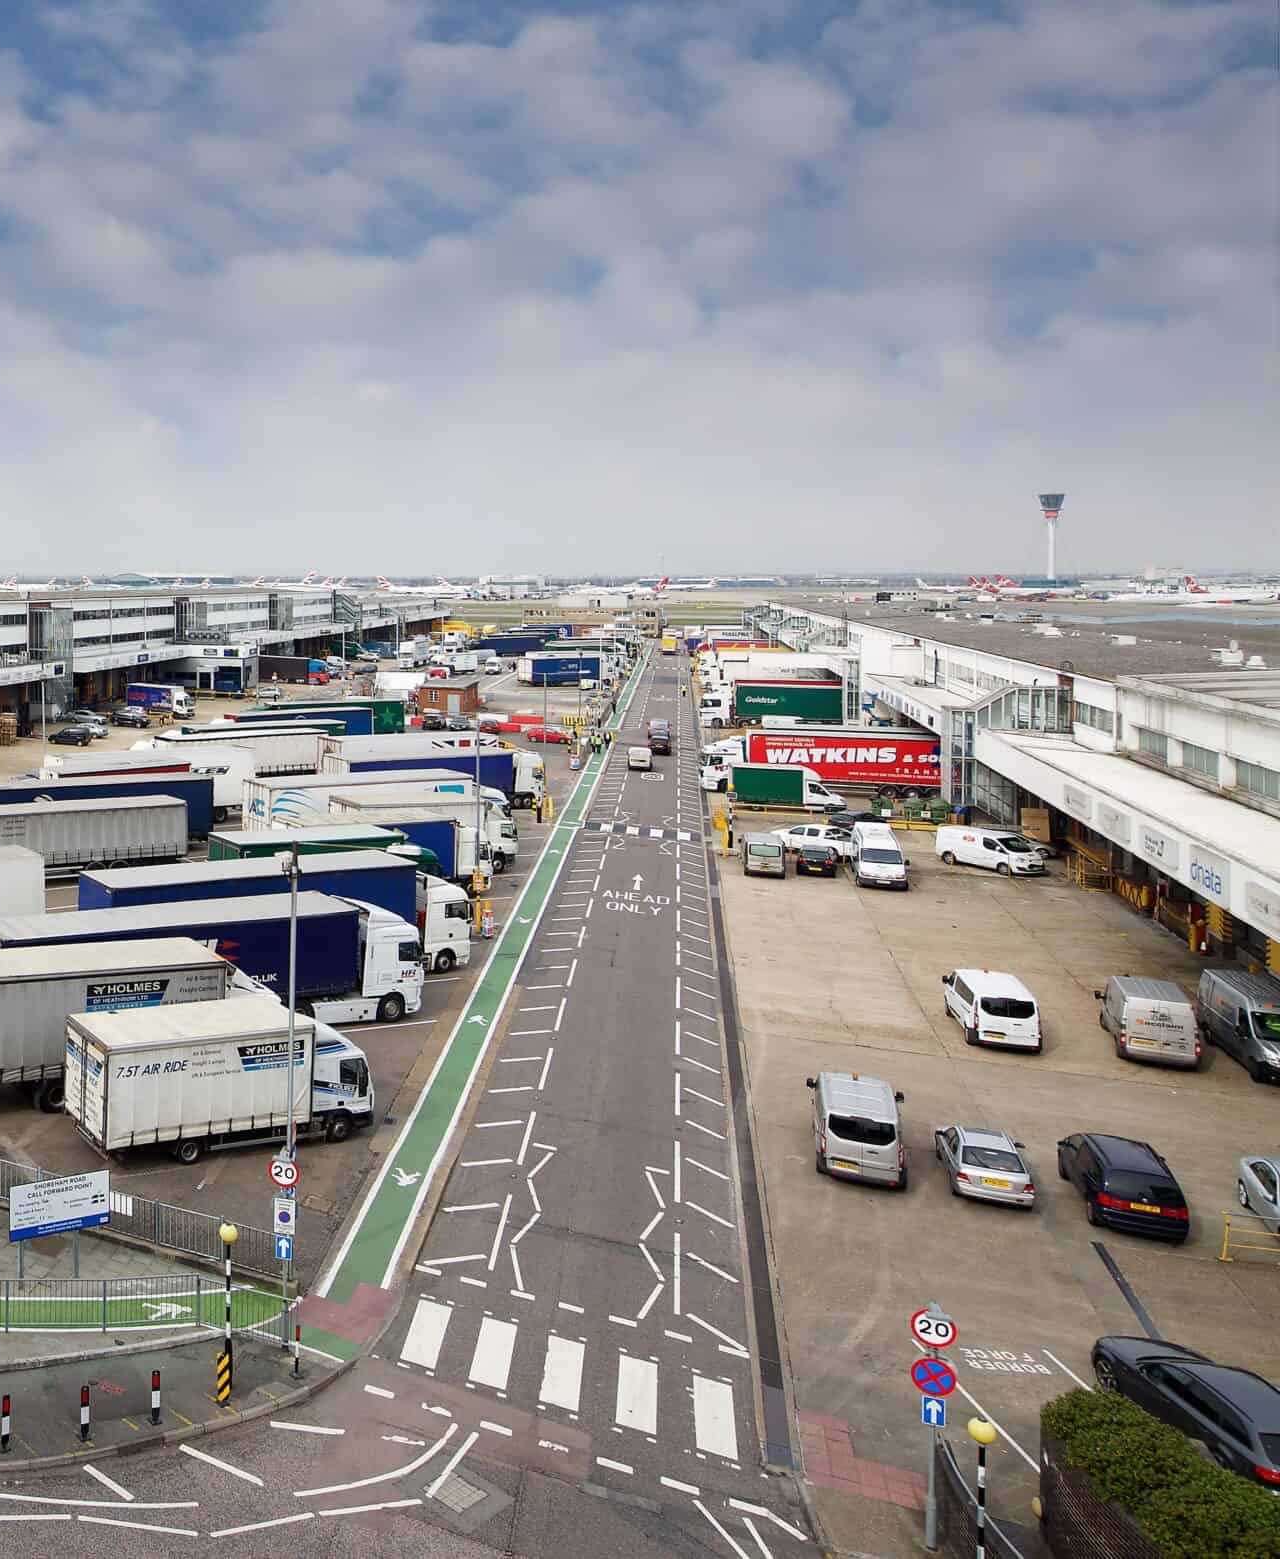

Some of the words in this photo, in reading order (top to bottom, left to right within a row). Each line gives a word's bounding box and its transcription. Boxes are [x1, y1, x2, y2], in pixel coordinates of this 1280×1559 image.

[765, 747, 897, 764] WATKINS
[902, 754, 914, 762] &
[919, 754, 941, 763] SO
[1190, 856, 1223, 895] dnata
[602, 890, 670, 905] AHEAD
[606, 902, 663, 916] ONLY
[108, 981, 161, 994] HOLMES
[256, 1042, 301, 1055] HOLMS
[116, 1065, 140, 1078] 7.5T
[141, 1064, 161, 1076] AIR
[163, 1061, 189, 1074] RIDE
[274, 1165, 295, 1180] 20
[34, 1179, 68, 1190] SHOREHAM
[70, 1176, 87, 1184] ROAD
[44, 1186, 74, 1196] FORWARD
[74, 1182, 94, 1192] POINT
[918, 1320, 950, 1338] 20
[966, 1359, 1052, 1375] BORDER
